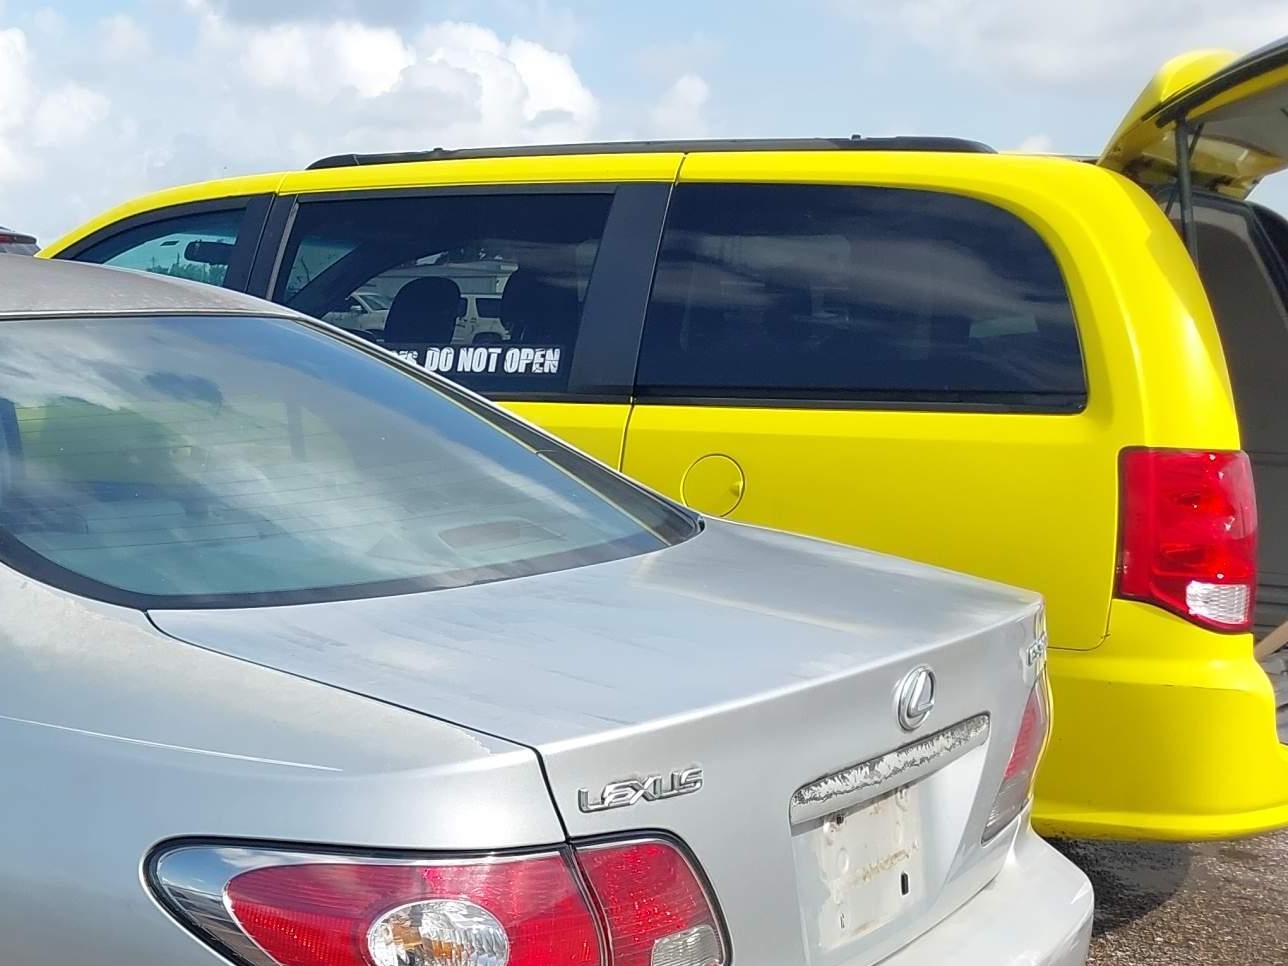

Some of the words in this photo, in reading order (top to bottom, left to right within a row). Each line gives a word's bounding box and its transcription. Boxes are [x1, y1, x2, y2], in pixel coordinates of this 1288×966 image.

[424, 347, 455, 371] DO
[456, 347, 502, 373] NOT
[503, 347, 561, 373] OPEN
[577, 767, 703, 813] LEXUS
